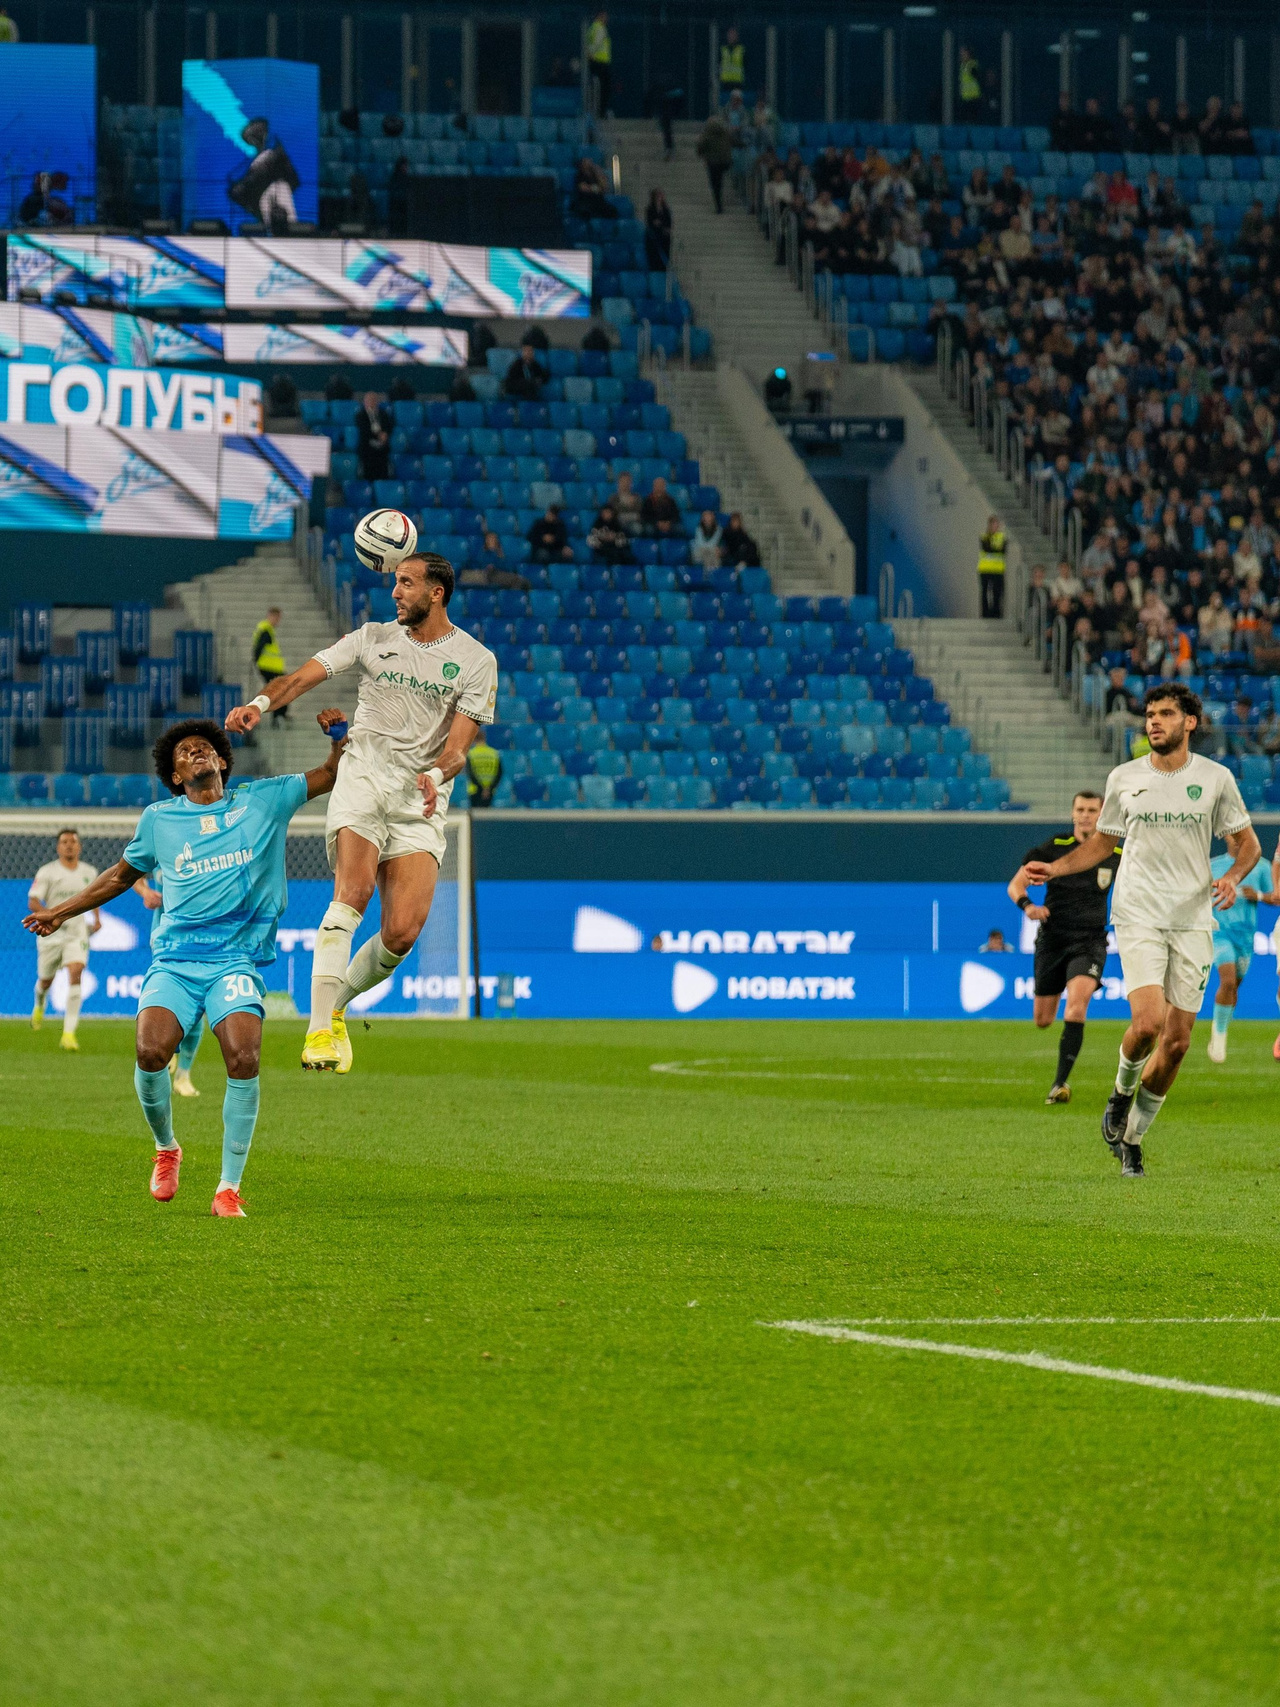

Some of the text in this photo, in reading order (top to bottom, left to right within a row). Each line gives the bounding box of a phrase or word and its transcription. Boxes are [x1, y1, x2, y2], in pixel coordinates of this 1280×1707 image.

[376, 671, 454, 696] AKHMAT
[389, 684, 437, 700] FOUNDATION
[1134, 812, 1207, 824] AKHMAT
[196, 848, 253, 874] ГАЗПРОМ
[223, 974, 254, 1002] 30
[727, 975, 856, 1000] НОВАТЭК
